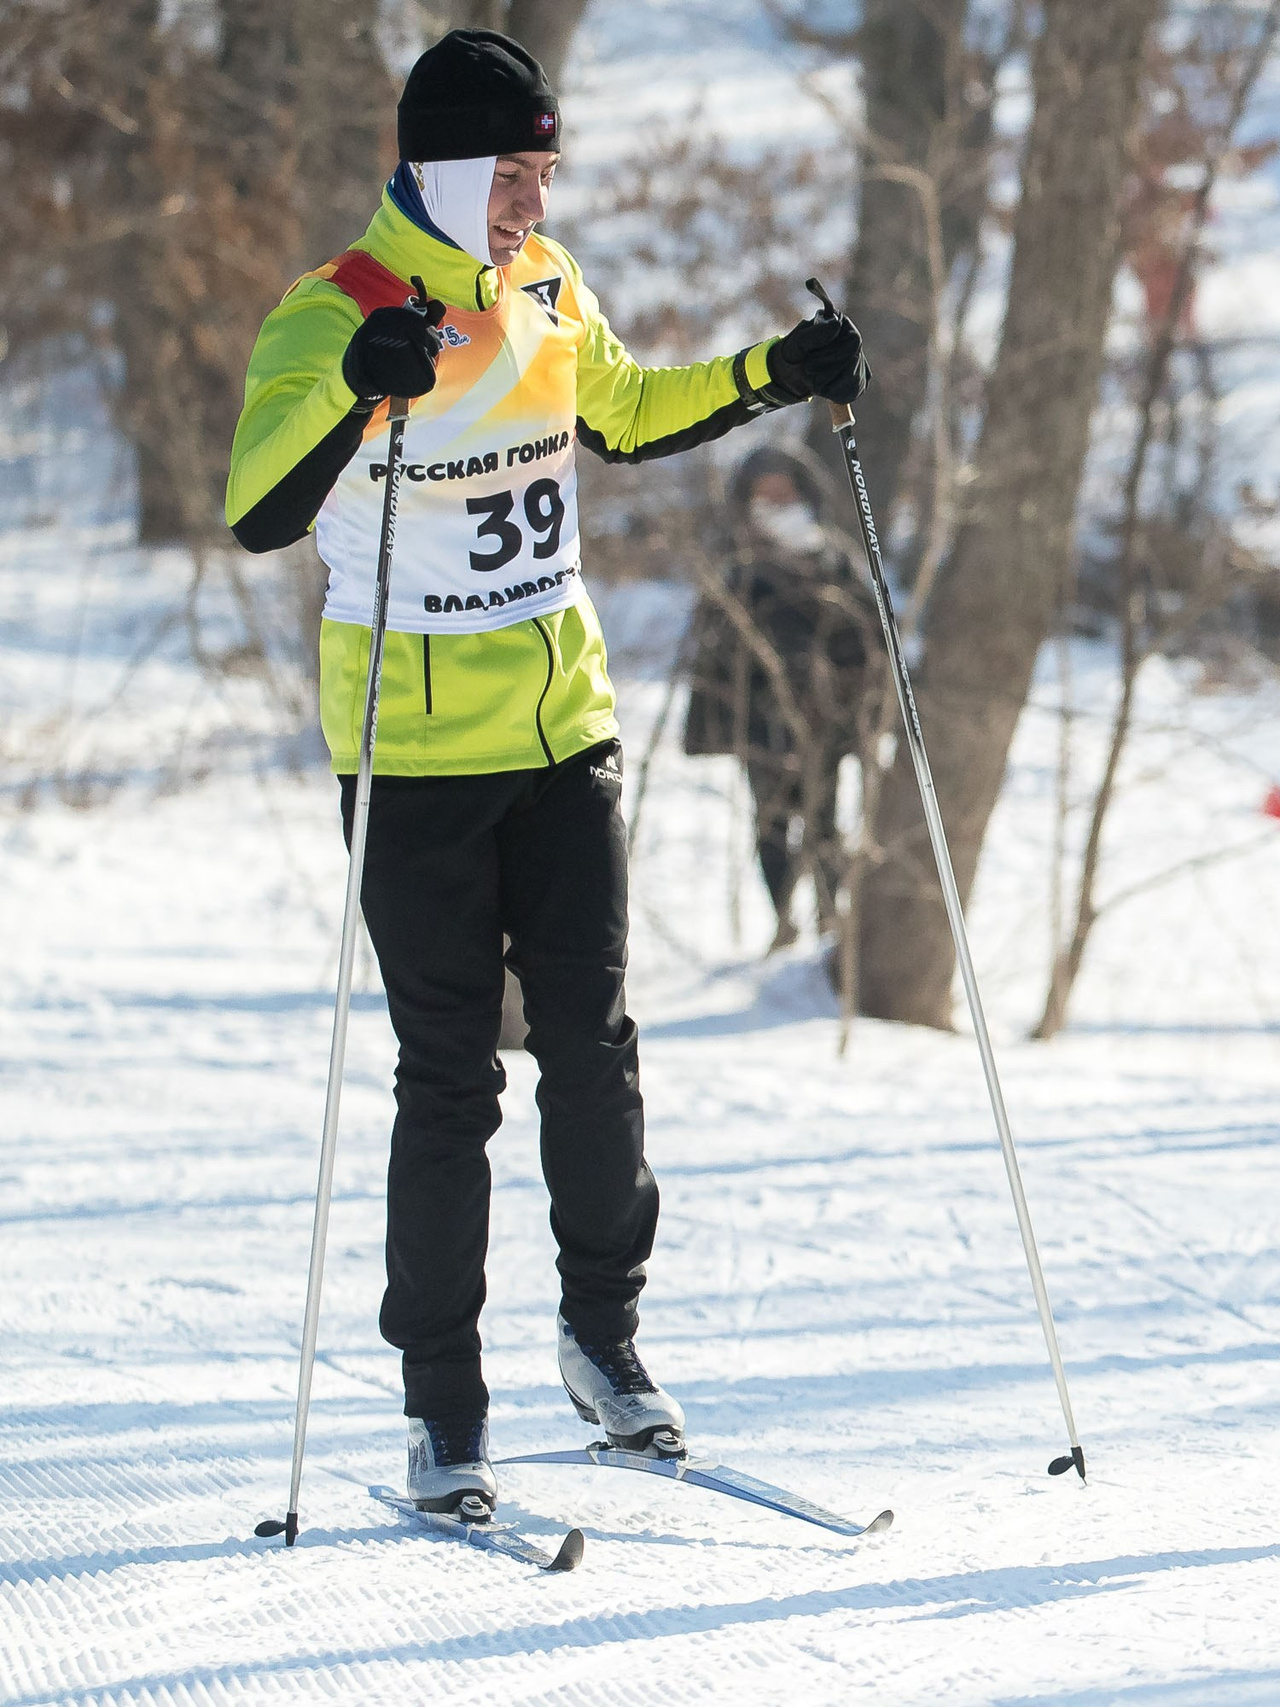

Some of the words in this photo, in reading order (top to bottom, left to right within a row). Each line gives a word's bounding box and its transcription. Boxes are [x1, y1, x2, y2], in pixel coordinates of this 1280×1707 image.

[507, 431, 569, 467] ГОНКА
[466, 478, 566, 572] 39
[851, 459, 881, 557] NORDWAY
